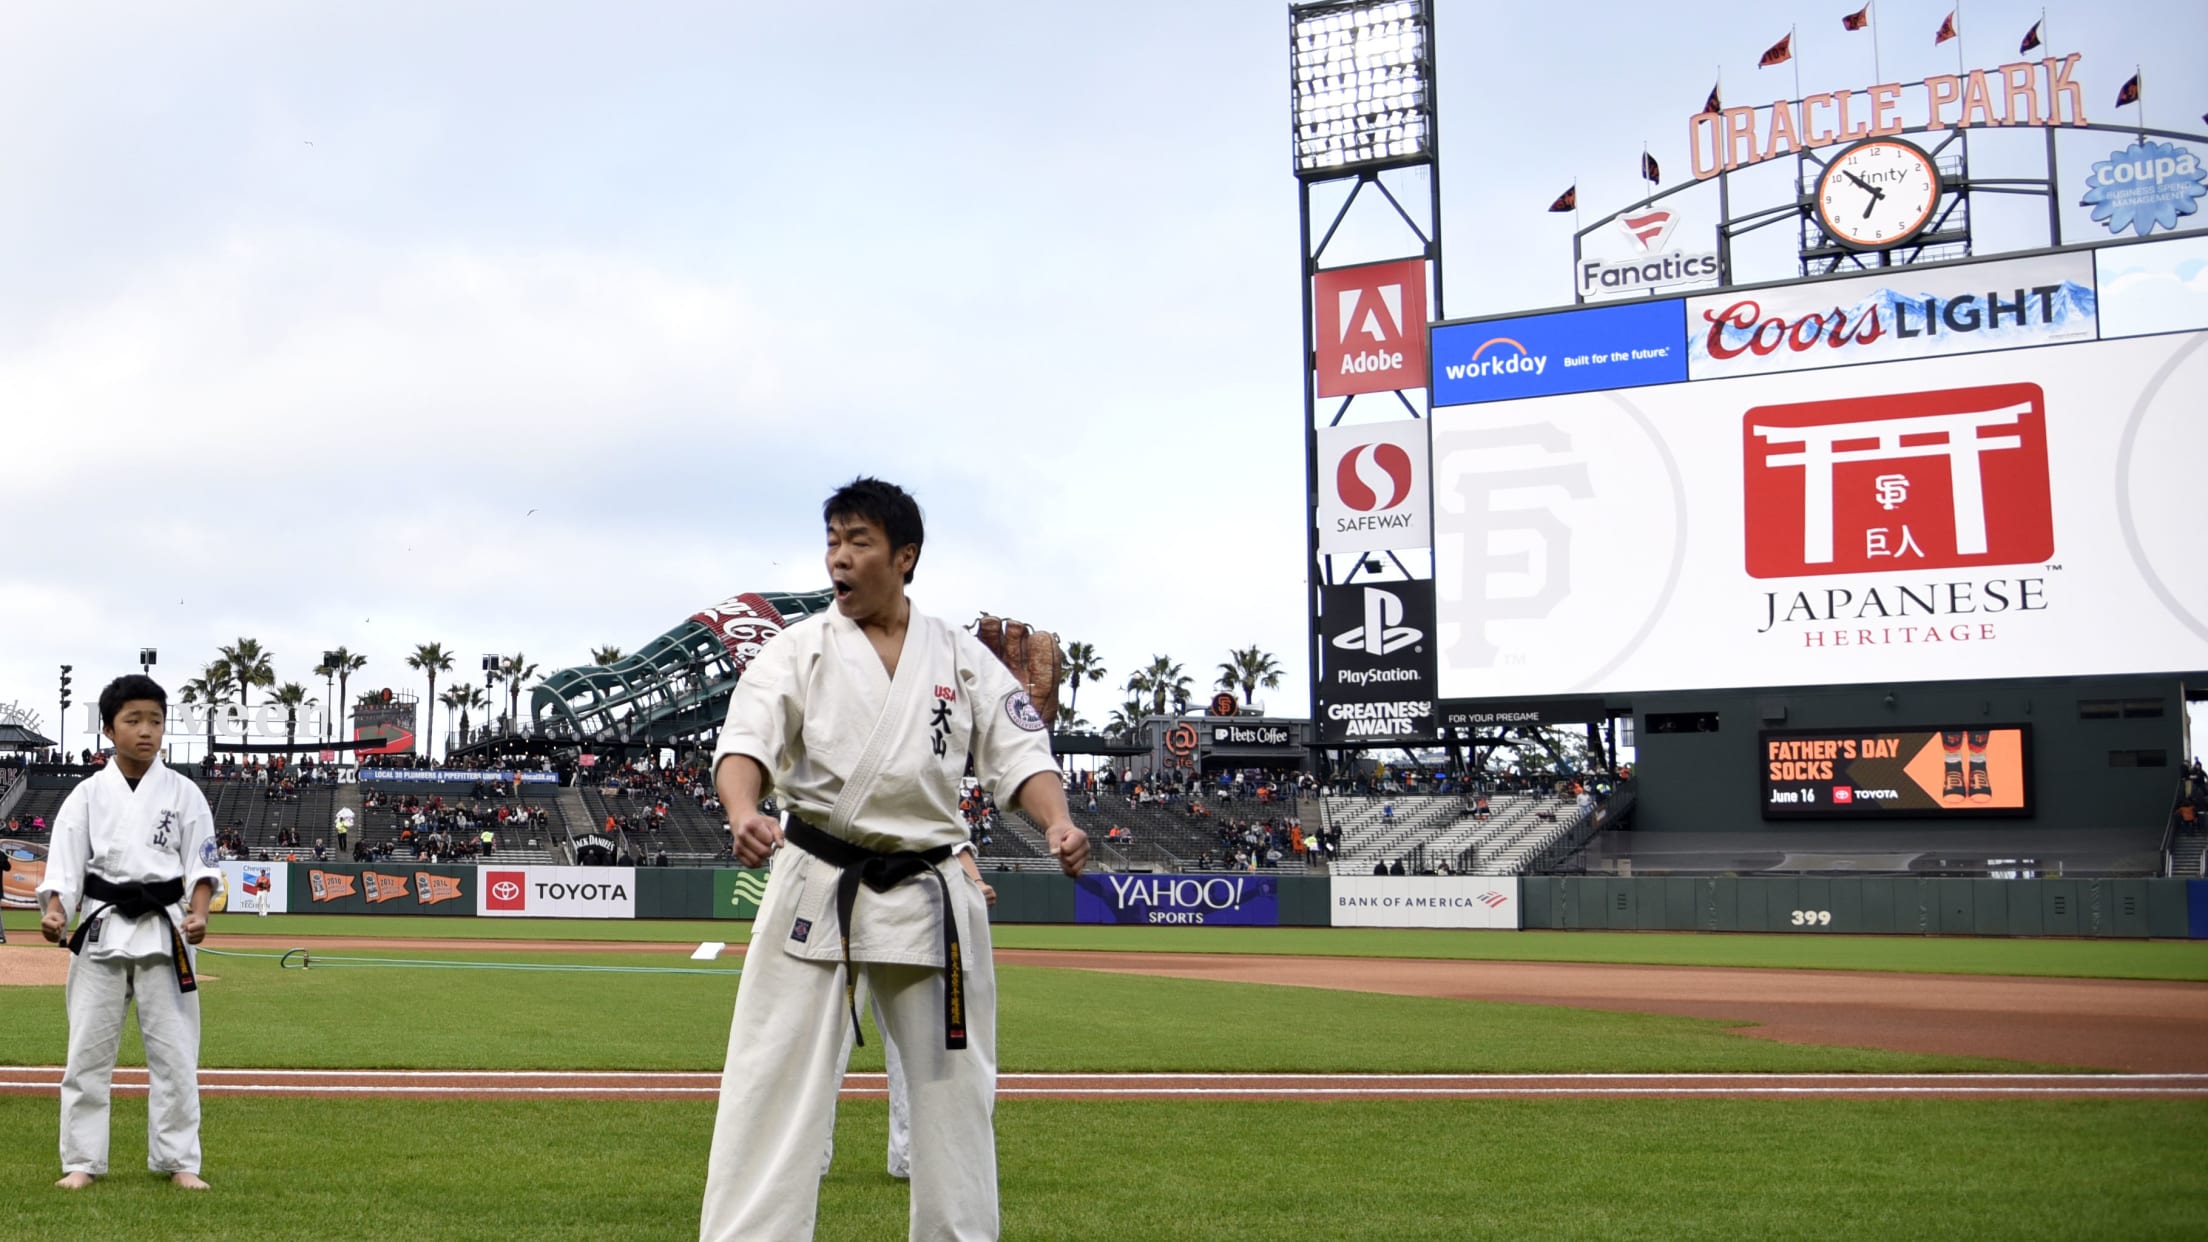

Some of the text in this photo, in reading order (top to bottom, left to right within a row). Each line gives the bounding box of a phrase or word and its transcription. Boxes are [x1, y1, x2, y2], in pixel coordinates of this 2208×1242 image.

[1689, 52, 2088, 180] ORACLE PARK
[1848, 156, 1858, 165] 11
[1870, 147, 1880, 156] 12
[1897, 150, 1902, 158] 1
[1915, 163, 1921, 172] 2
[2097, 154, 2196, 185] coupa
[1832, 174, 1842, 183] 10
[1849, 168, 1908, 186] finity
[1923, 182, 1929, 191] 3
[1826, 196, 1832, 204] 9
[1916, 205, 1922, 213] 4
[1834, 215, 1840, 224] 8
[1899, 221, 1905, 230] 5
[1852, 227, 1858, 236] 7
[1876, 230, 1882, 239] 6
[1584, 253, 1717, 290] Fanatics
[1703, 285, 2062, 360] Coors LIGHT
[1341, 349, 1403, 375] Adobe
[1446, 353, 1547, 380] workday
[1564, 355, 1589, 367] Built
[1592, 353, 1608, 364] for
[1611, 351, 1629, 362] the
[1337, 513, 1412, 533] SAFEWAY
[1866, 524, 1925, 559] 巨人
[1757, 578, 2048, 633] JAPANESE
[1804, 624, 1997, 648] HERITAGE
[1338, 668, 1418, 686] PlayStation
[934, 684, 956, 702] USA
[1328, 701, 1431, 721] GREATNESS
[1449, 712, 1539, 724] FOR YOUR PREGAME
[930, 699, 952, 760] 大山
[1256, 727, 1288, 745] Coffee
[1345, 718, 1414, 736] AWAITS
[1769, 738, 1900, 760] FATHER'S DAY
[403, 771, 437, 779] PLUMBERS
[444, 771, 481, 779] PIPEFITTERS
[1769, 761, 1833, 780] SOCKS
[1770, 788, 1815, 803] June 16
[1854, 790, 1899, 799] TOYOTA
[153, 816, 172, 847] 大山
[535, 883, 627, 901] TOYOTA
[1109, 875, 1244, 911] YAHOO!
[1339, 896, 1473, 908] BANK OF AMERICA
[1149, 912, 1204, 924] SPORTS
[1791, 910, 1831, 925] 399
